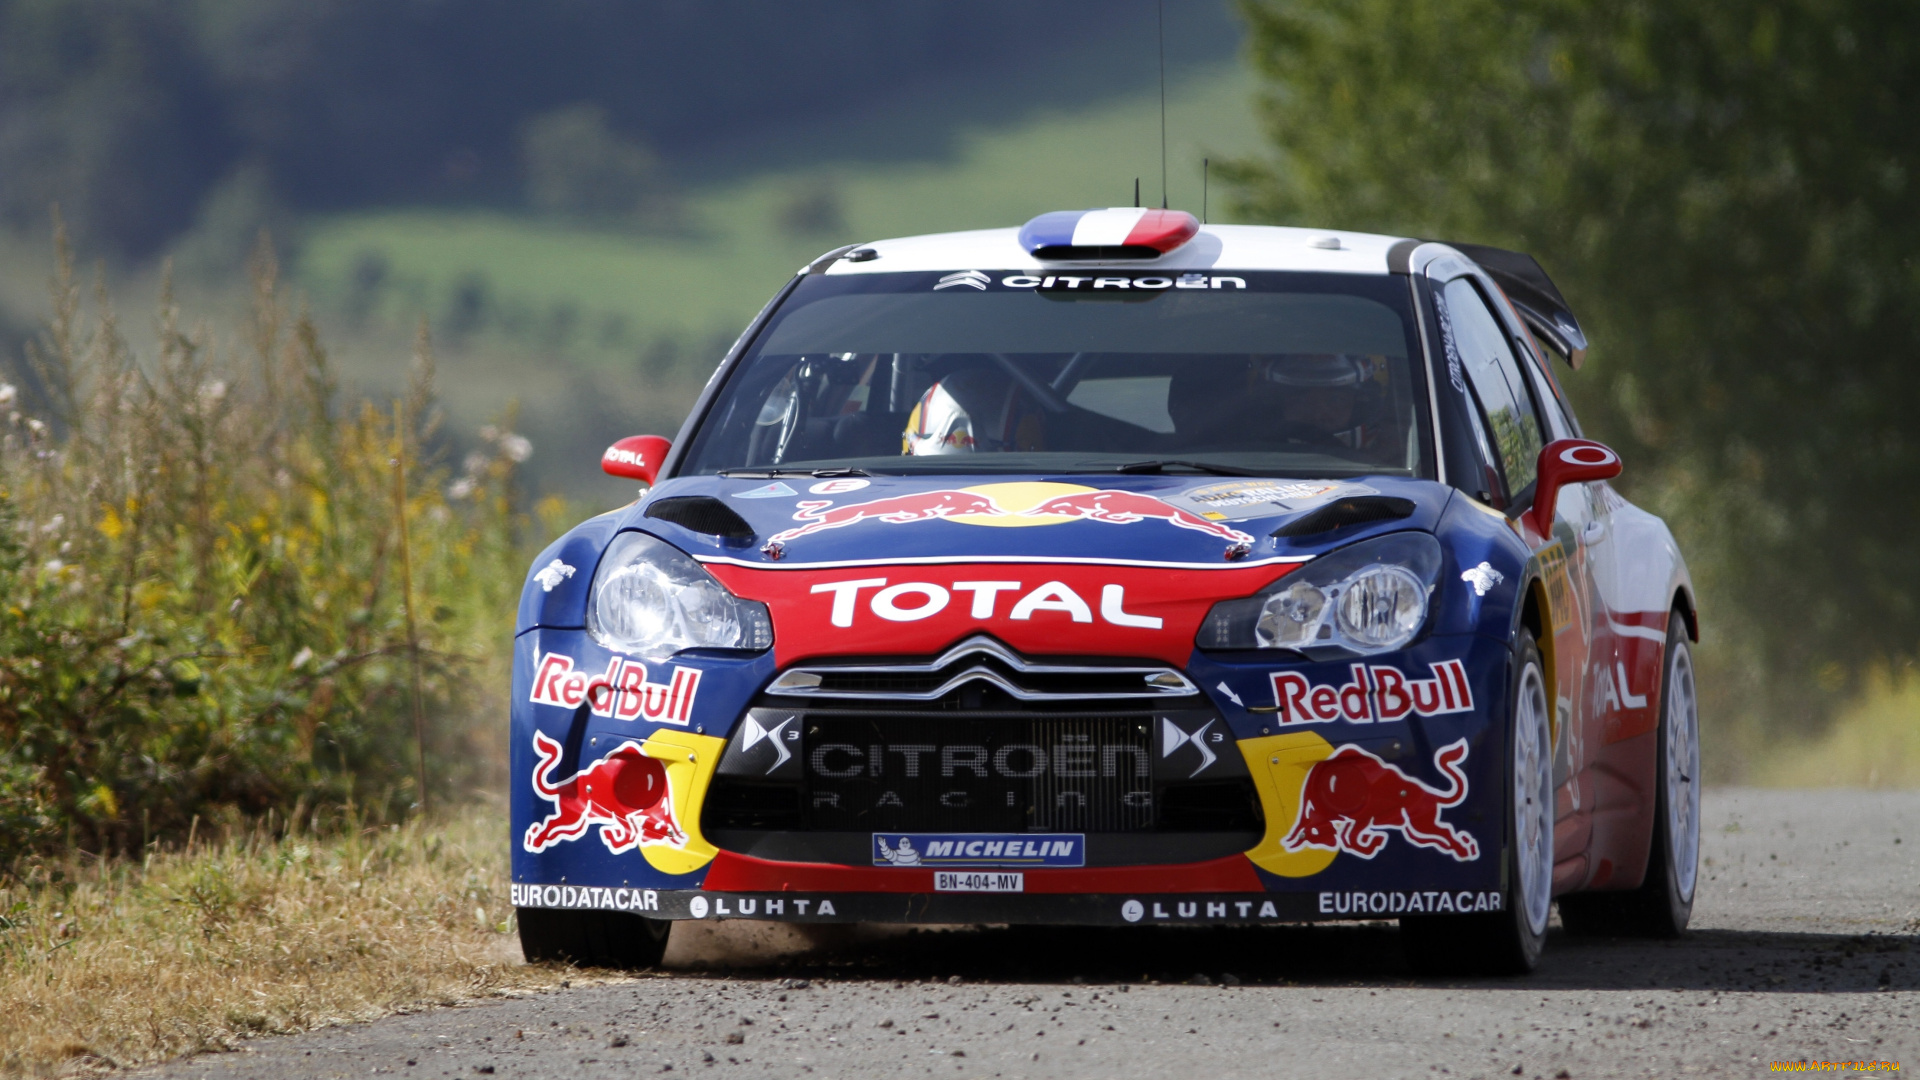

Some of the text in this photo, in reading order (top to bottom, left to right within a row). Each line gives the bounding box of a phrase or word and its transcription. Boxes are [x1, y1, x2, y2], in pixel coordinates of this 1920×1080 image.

[1002, 273, 1246, 289] CITROËN
[605, 446, 645, 467] TOTAL
[810, 577, 1163, 630] TOTAL
[813, 791, 1151, 808] RACING
[925, 841, 1074, 857] MICHELIN
[939, 874, 1018, 890] BN-404-MV
[511, 884, 659, 911] EURODATACAR
[1319, 891, 1501, 913] EURODATACAR
[716, 898, 836, 916] LUHTA
[1153, 901, 1278, 918] LUHTA
